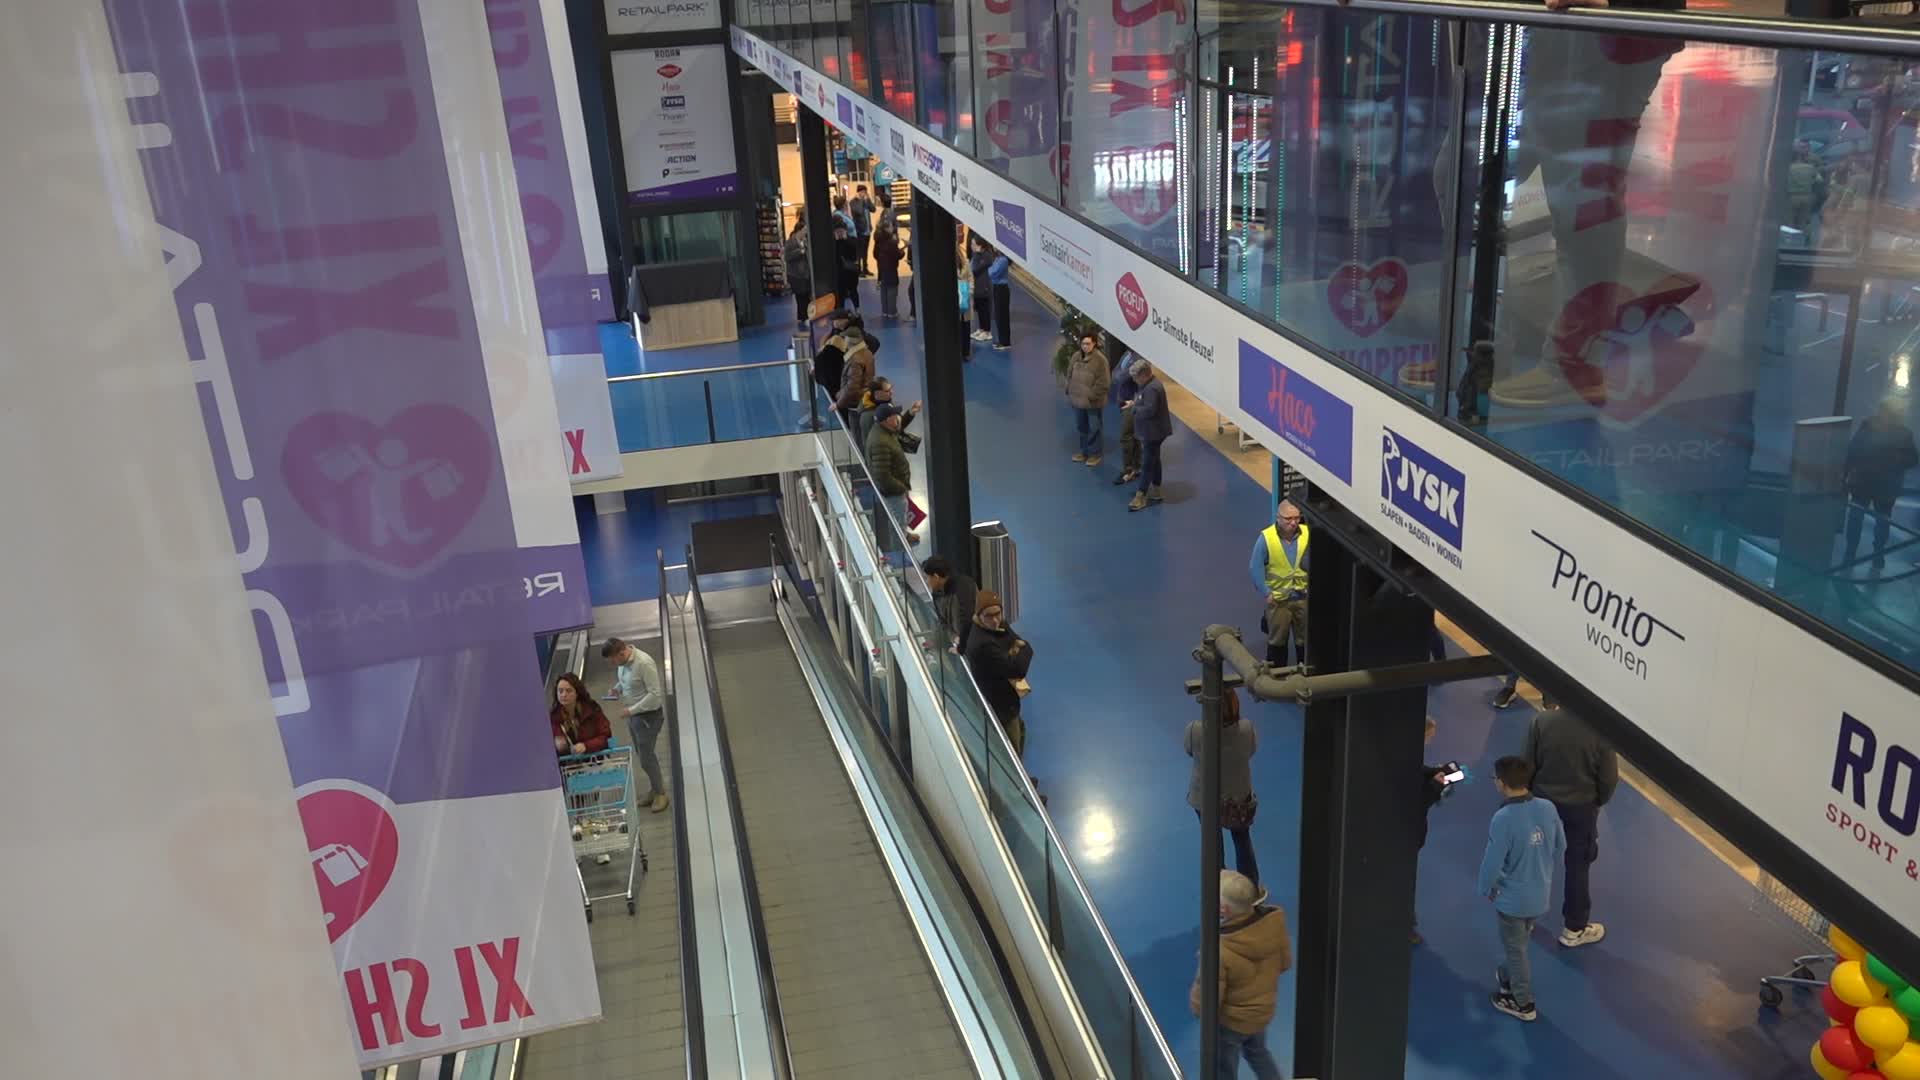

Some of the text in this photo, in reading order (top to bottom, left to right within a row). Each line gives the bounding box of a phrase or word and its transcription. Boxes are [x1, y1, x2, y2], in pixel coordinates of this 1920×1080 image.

[618, 3, 705, 17] RETAILPARK
[667, 154, 697, 164] ACTION
[1152, 307, 1214, 364] De slimste keuze!
[1267, 363, 1318, 438] Haco
[1397, 456, 1460, 528] JYSK
[1381, 503, 1463, 570] SLAPEN BADEN WONEN
[1531, 529, 1685, 648] Pronto
[1586, 622, 1648, 681] wonen
[1825, 803, 1920, 881] SPORT &
